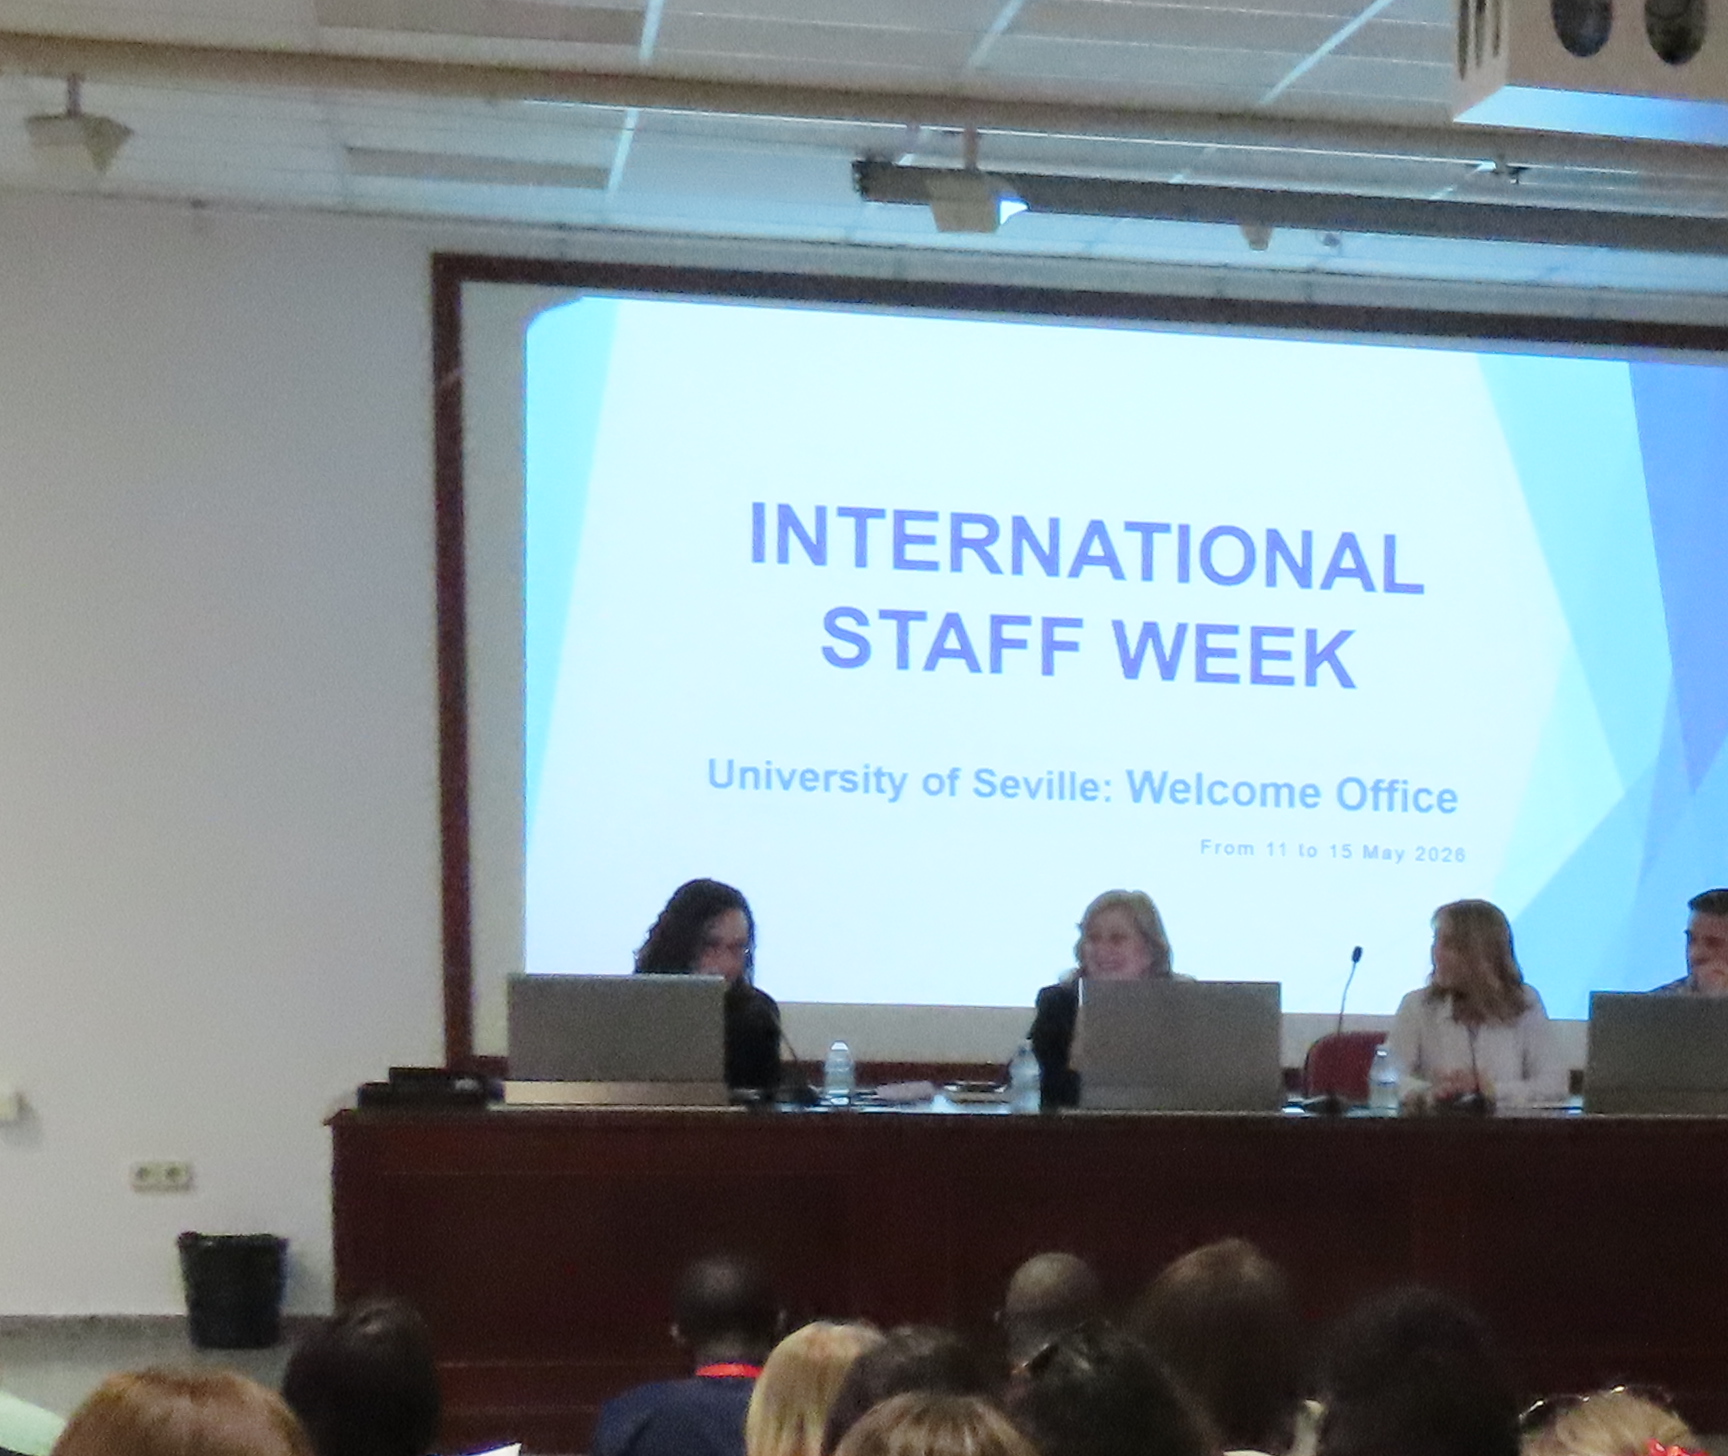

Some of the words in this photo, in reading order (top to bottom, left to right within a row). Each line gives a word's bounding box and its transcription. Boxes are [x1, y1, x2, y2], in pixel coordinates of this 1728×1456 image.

[749, 501, 1426, 596] INTERNATIONAL
[819, 604, 1087, 679] STAFF
[1110, 617, 1359, 692] WEEK
[706, 757, 910, 804] University
[920, 766, 963, 798] of
[972, 767, 1113, 804] Seville:
[1124, 768, 1324, 811] Welcome
[1335, 776, 1460, 816] Office
[1200, 838, 1256, 857] From
[1266, 841, 1287, 857] 11
[1298, 843, 1319, 859] to
[1330, 843, 1353, 860] 15
[1362, 844, 1406, 865] May
[1414, 845, 1467, 864] 2026
